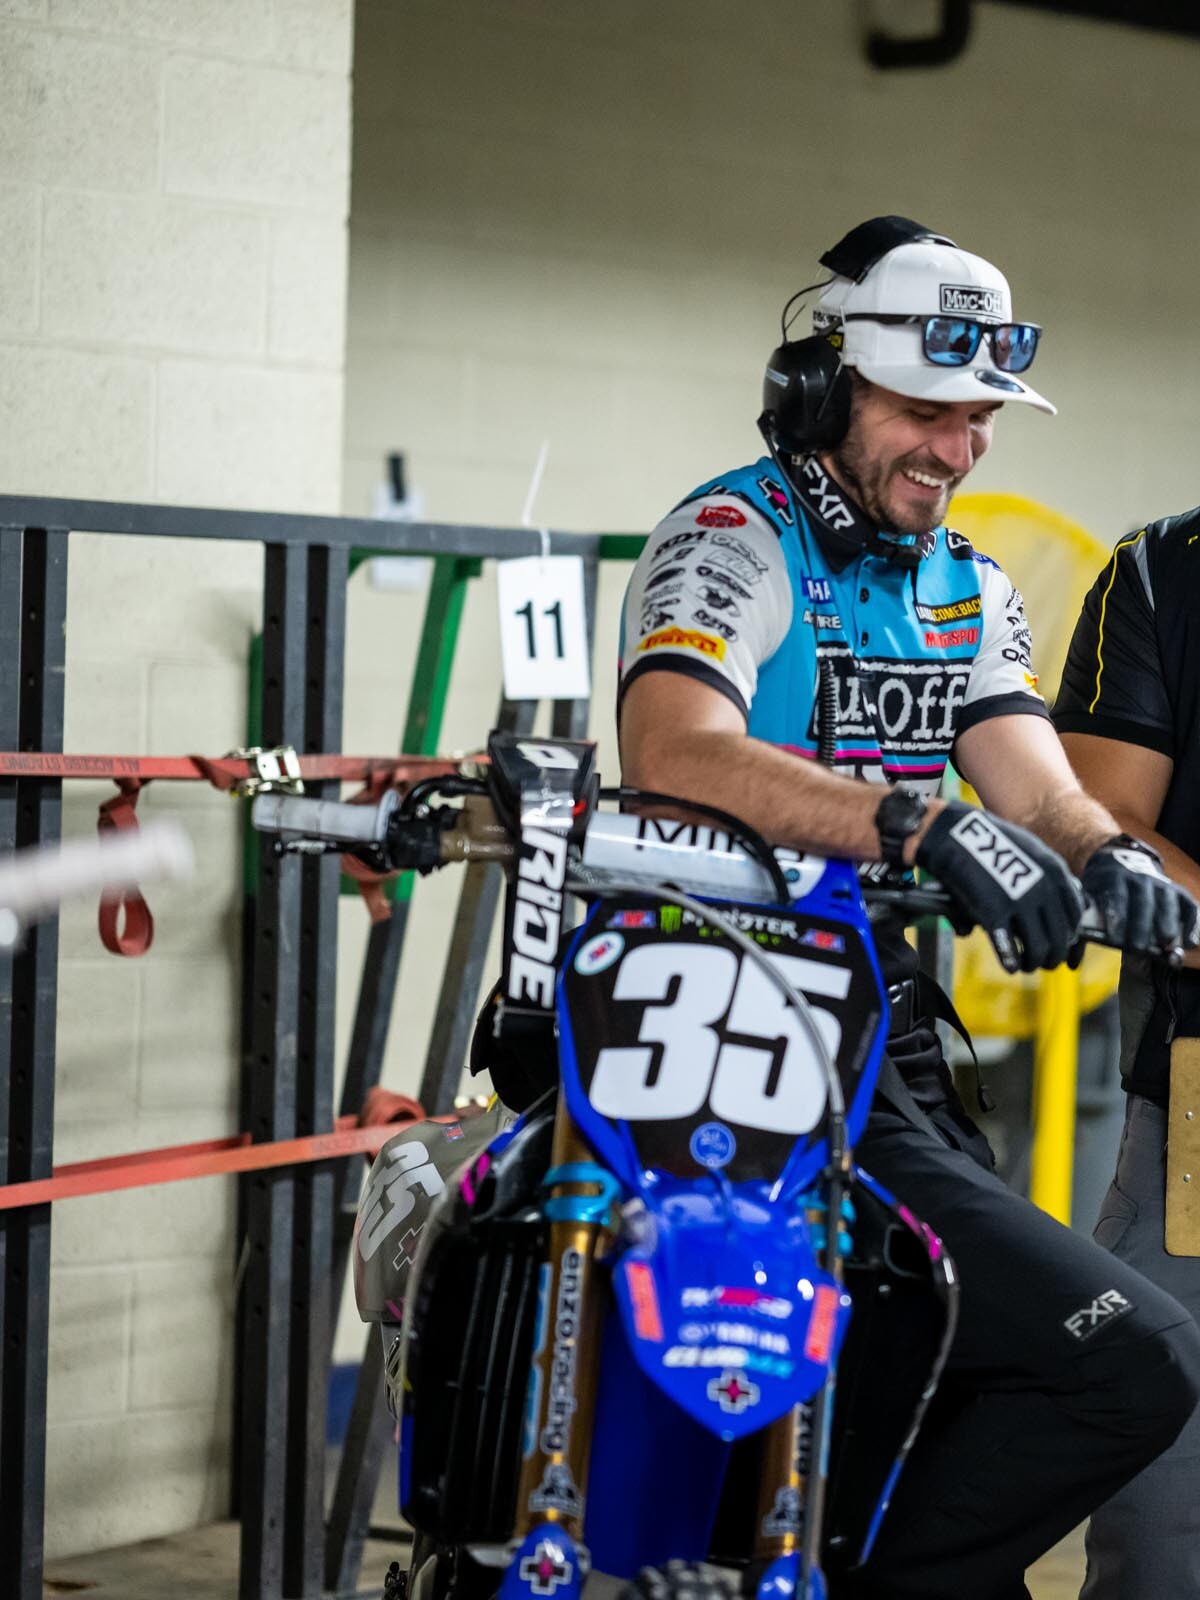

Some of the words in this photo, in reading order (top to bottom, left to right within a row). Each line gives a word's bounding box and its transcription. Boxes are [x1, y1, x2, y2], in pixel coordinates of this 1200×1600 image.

[803, 457, 855, 530] FXR
[515, 600, 566, 659] 11
[960, 818, 1032, 889] FXR
[588, 942, 853, 1135] 35
[1064, 1289, 1128, 1338] FXR
